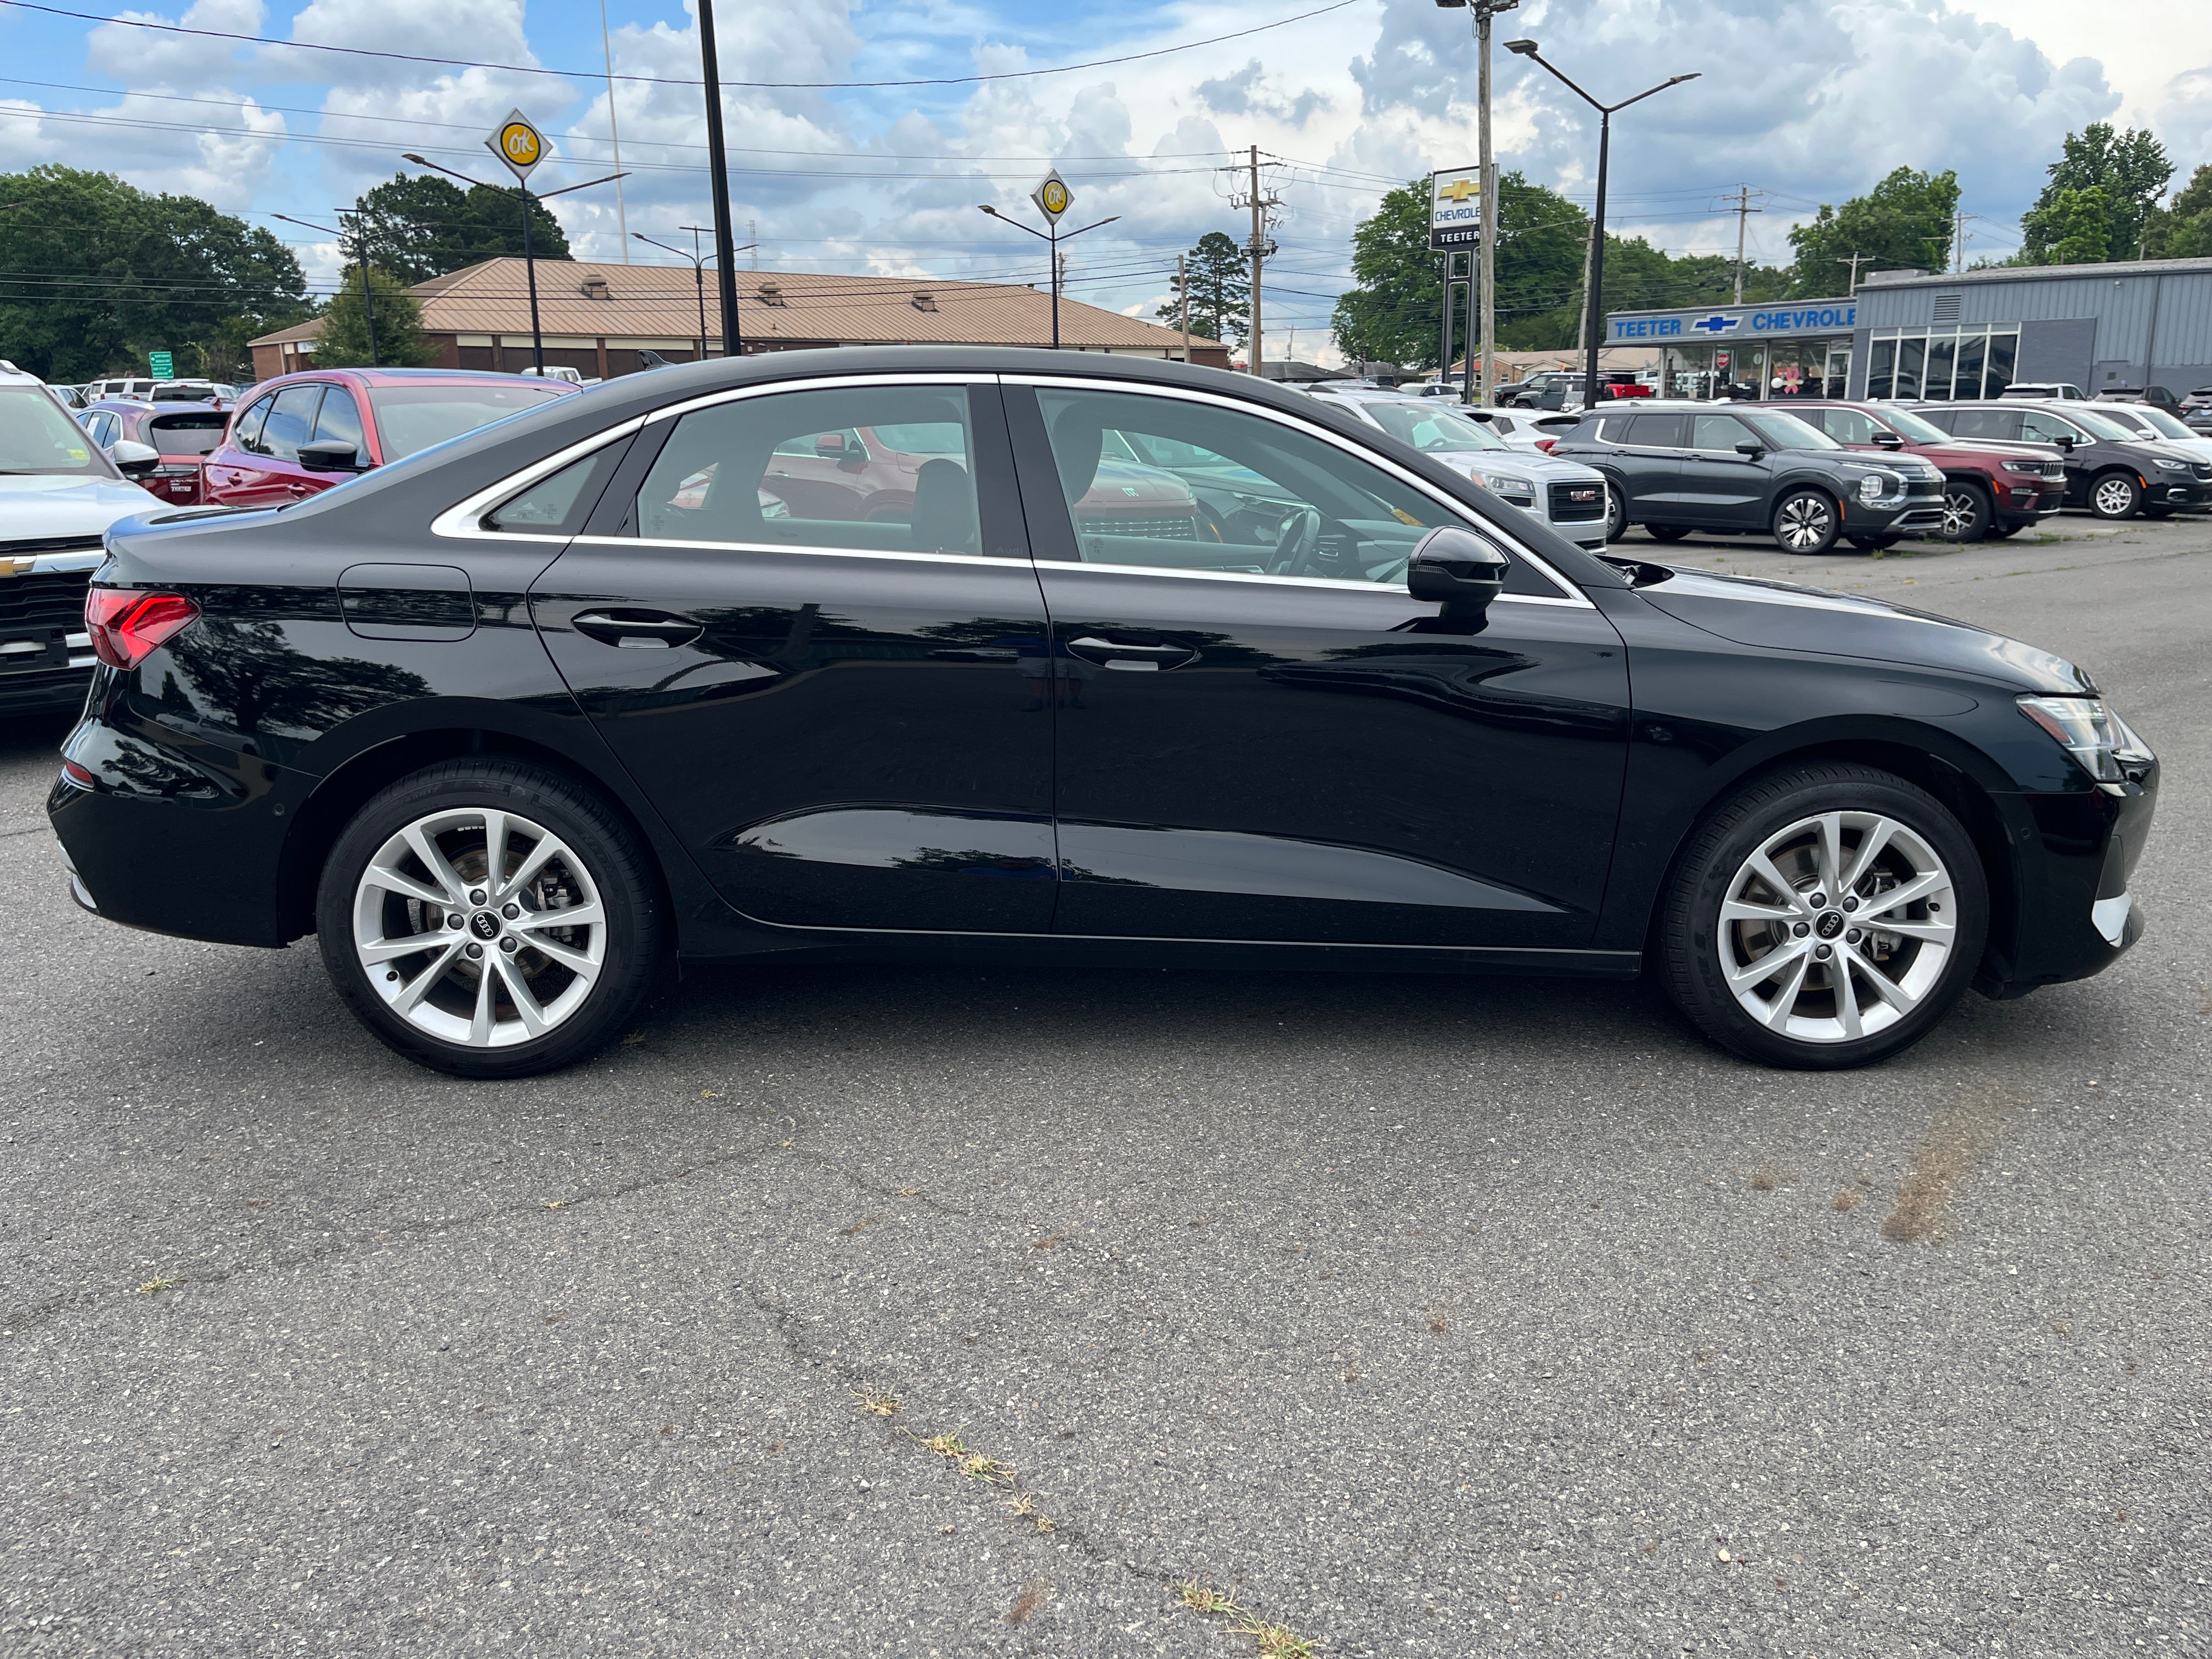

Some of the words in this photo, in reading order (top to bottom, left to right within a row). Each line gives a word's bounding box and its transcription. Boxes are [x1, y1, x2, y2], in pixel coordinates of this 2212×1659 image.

[509, 129, 535, 155] OK
[1048, 186, 1064, 205] OK
[1435, 207, 1481, 222] CHEVROLE
[1440, 230, 1480, 243] TEETER
[1615, 319, 1681, 337] TEETER
[1753, 308, 1857, 330] CHEVROLE
[1570, 490, 1596, 501] GMC
[996, 545, 1023, 555] Audi
